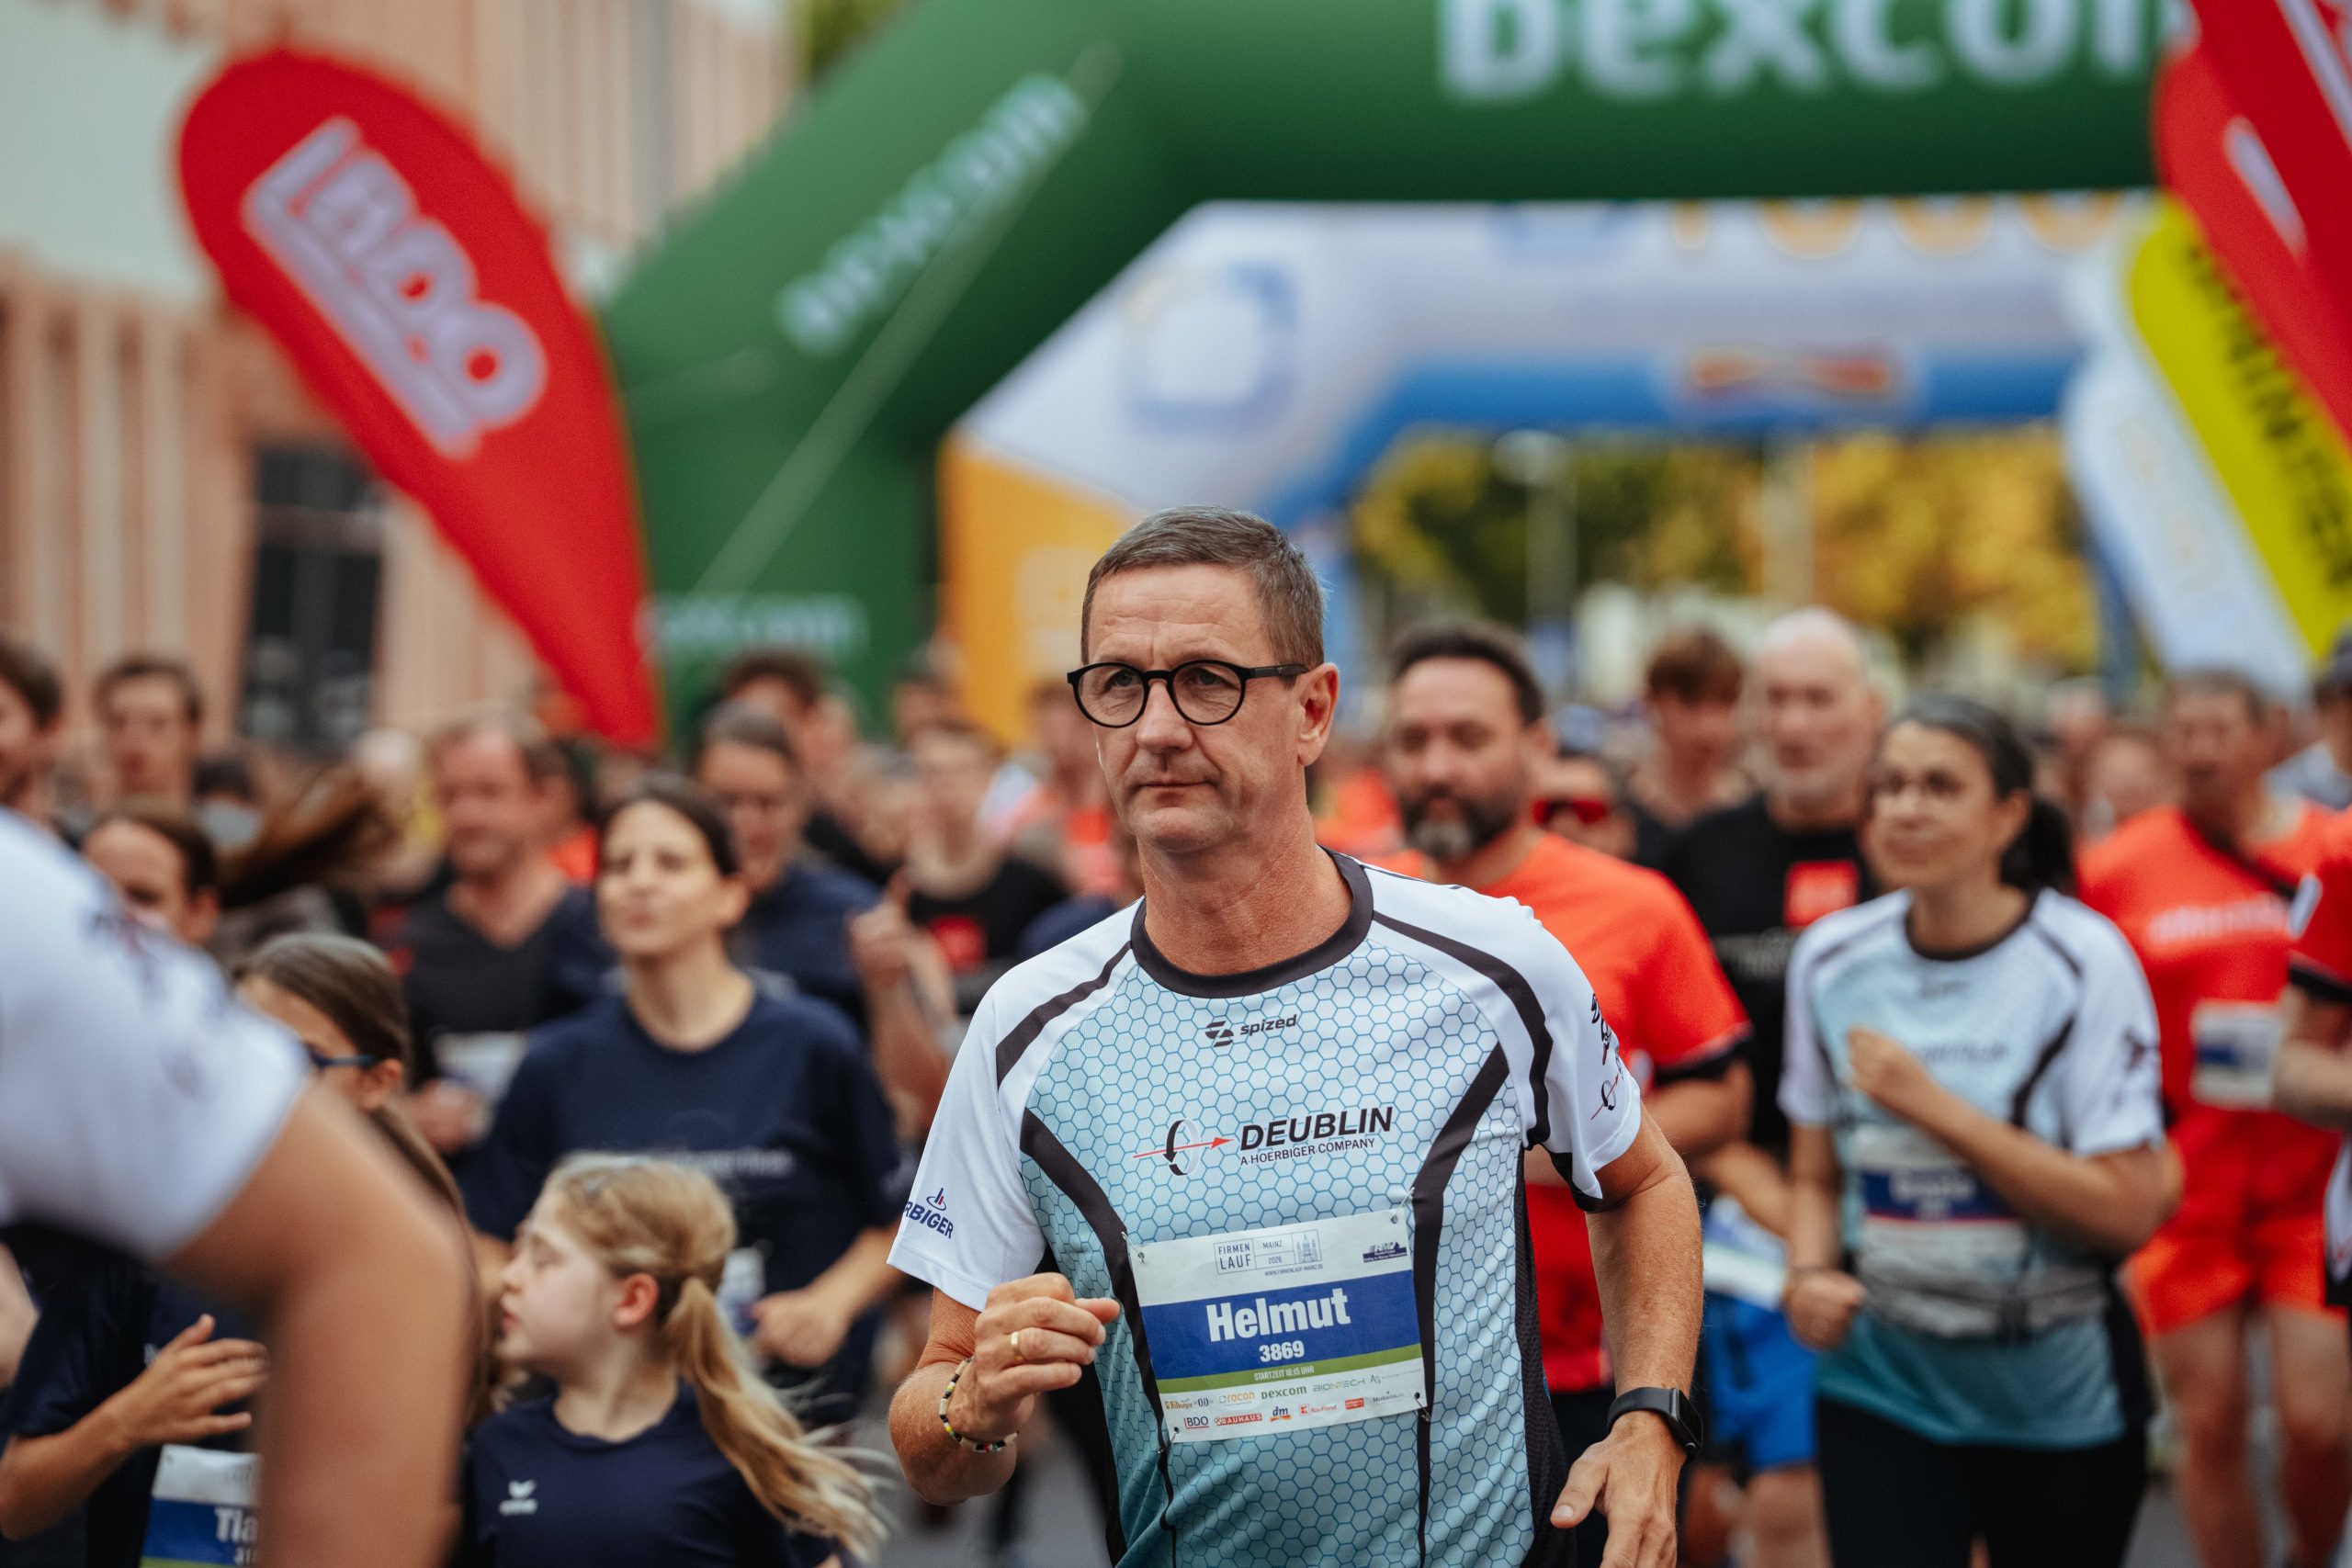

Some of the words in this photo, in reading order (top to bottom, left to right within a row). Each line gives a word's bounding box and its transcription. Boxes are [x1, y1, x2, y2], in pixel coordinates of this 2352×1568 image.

[1240, 1014, 1297, 1036] spized
[1240, 1106, 1393, 1151] DEUBLIN
[1240, 1156, 1249, 1166] A
[1251, 1145, 1316, 1163] HOERBIGER
[1318, 1138, 1375, 1154] COMPANY
[1218, 1243, 1250, 1255] FIRMEN
[1262, 1240, 1283, 1249] MAINZ
[1219, 1254, 1251, 1269] LAUF
[1205, 1288, 1351, 1342] Helmut
[1259, 1340, 1305, 1362] 3869
[1253, 1369, 1284, 1381] STARTZEIT
[1300, 1365, 1315, 1375] UHR
[1272, 1406, 1288, 1416] dm
[1186, 1416, 1209, 1427] BDO
[1221, 1414, 1261, 1425] BAUHAUS
